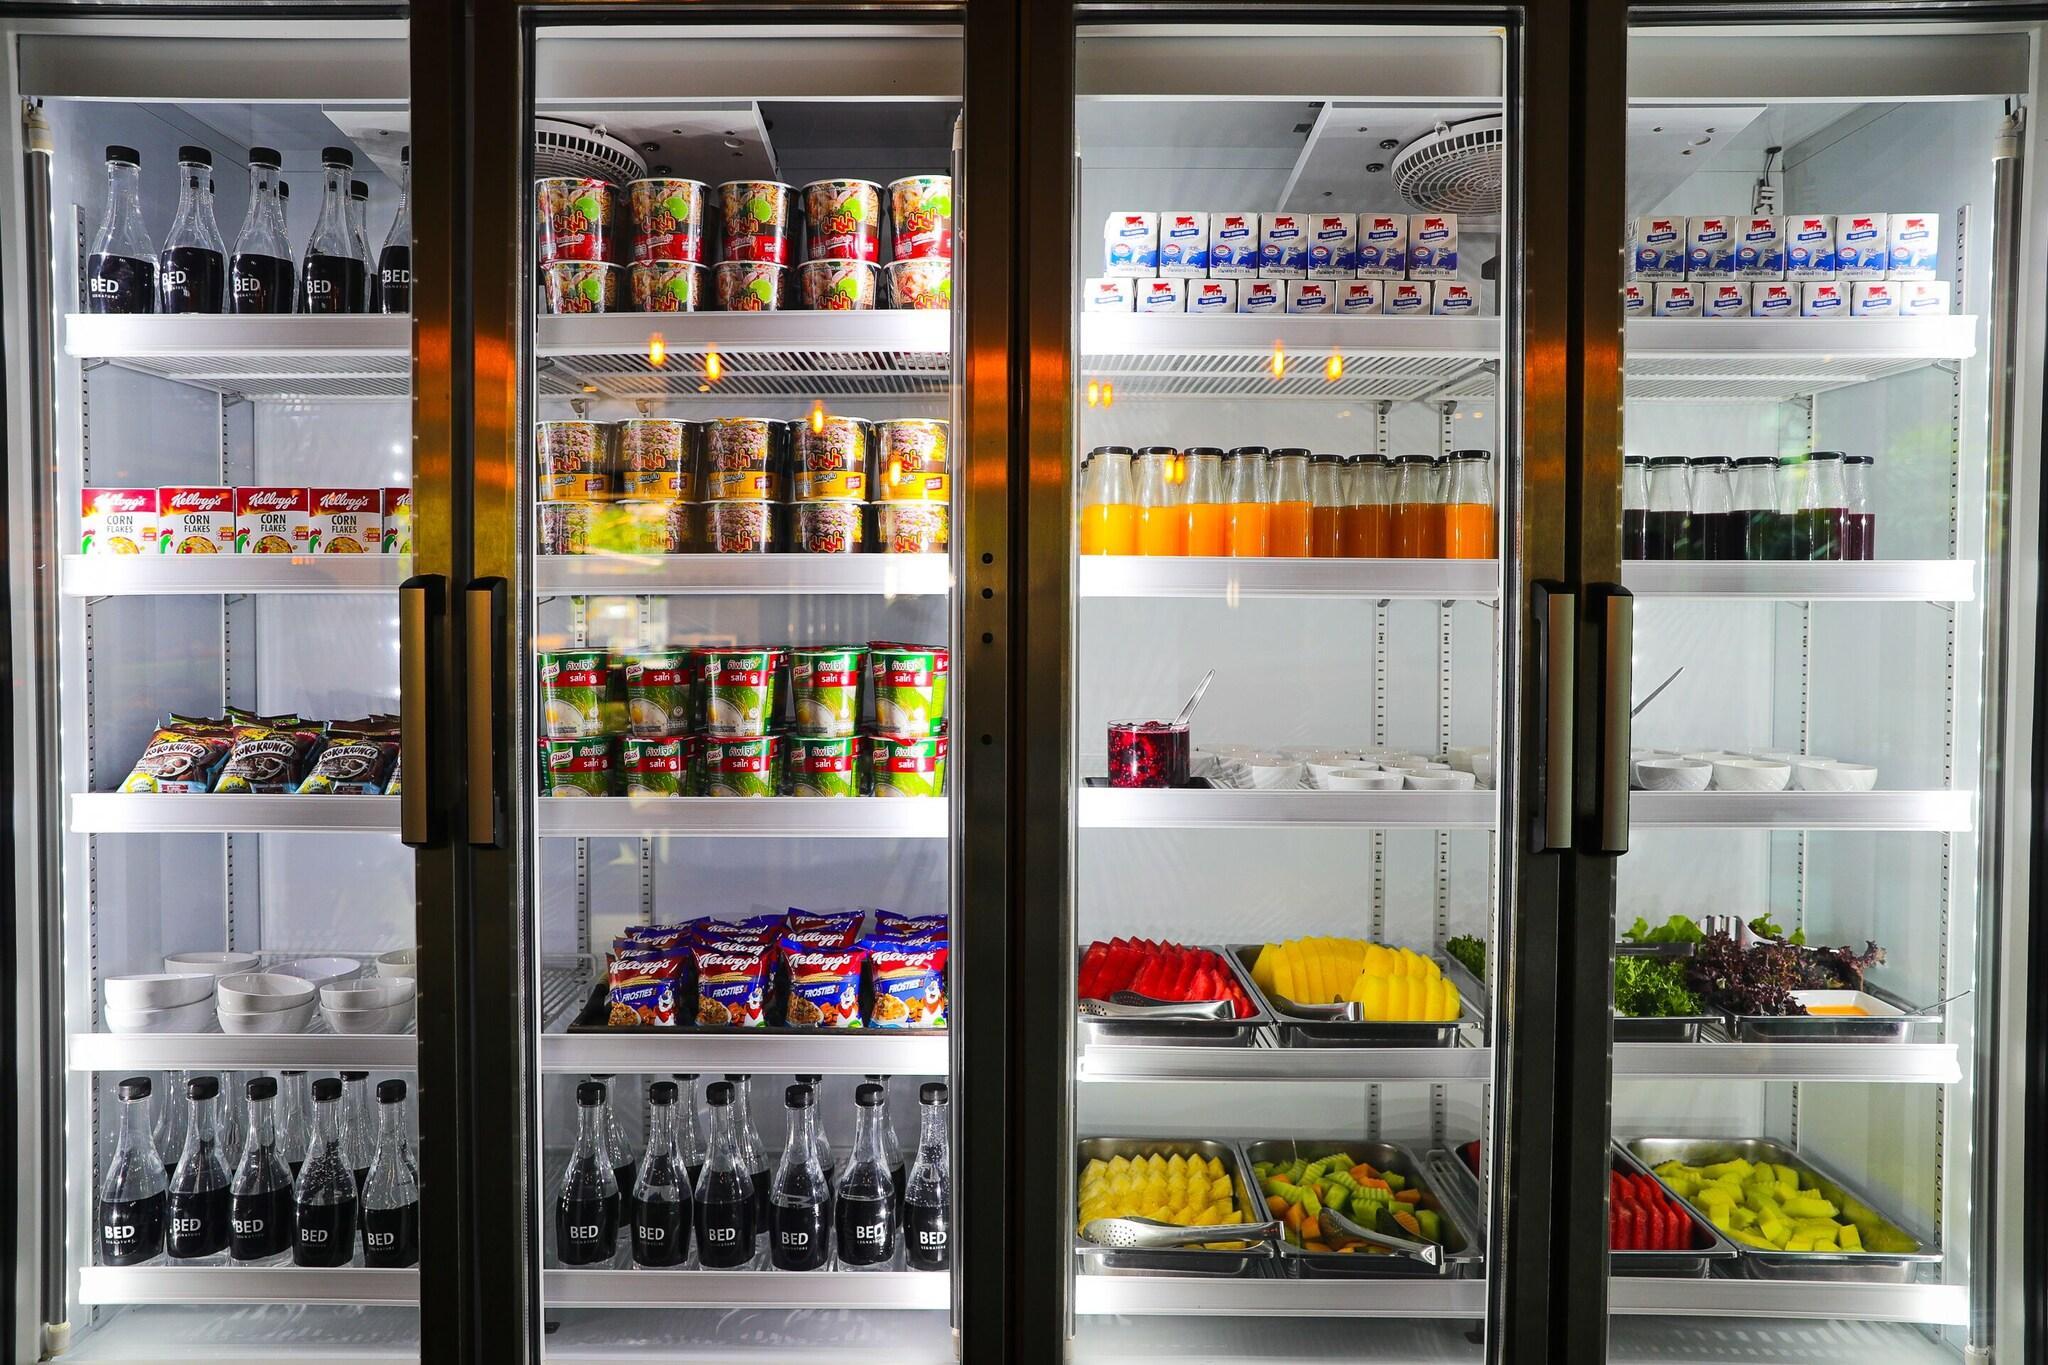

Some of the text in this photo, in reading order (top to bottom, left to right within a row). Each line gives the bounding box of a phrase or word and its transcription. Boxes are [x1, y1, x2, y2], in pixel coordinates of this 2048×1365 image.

[162, 271, 187, 287] BED
[385, 270, 410, 283] BED
[91, 278, 119, 293] BED
[235, 278, 261, 292] BED
[307, 280, 331, 293] BED
[94, 492, 144, 511] Kellogg's
[171, 492, 221, 511] Kellogg's
[248, 492, 297, 510] Kellogg's
[319, 493, 368, 511] Kellogg's
[107, 515, 133, 525] CORN
[183, 514, 210, 525] CORN
[260, 514, 286, 524] CORN
[331, 515, 357, 525] CORN
[184, 525, 211, 533] FLAKES
[260, 524, 287, 532] FLAKES
[331, 525, 357, 534] FLAKES
[168, 742, 203, 756] KRUNCH
[256, 741, 293, 755] KRUNCH
[343, 747, 375, 757] KRUNCH
[699, 952, 760, 971] Kellogg's
[788, 953, 852, 971] Kellogg's
[871, 951, 936, 966] Kellogg's
[610, 958, 671, 974] Kellogg's
[711, 985, 743, 998] FROSTIES
[803, 985, 834, 998] FROSTIES
[887, 979, 919, 993] FROSTIES
[621, 988, 652, 1002] FROSTIES
[174, 1218, 201, 1232] BED
[235, 1219, 263, 1234] BED
[570, 1225, 599, 1239] BED
[856, 1224, 884, 1239] BED
[105, 1225, 135, 1240] BED
[302, 1228, 328, 1242] BED
[368, 1233, 394, 1246] BED
[639, 1226, 665, 1241] BED
[708, 1227, 735, 1241] BED
[781, 1231, 809, 1245] BED
[919, 1231, 947, 1245] BED
